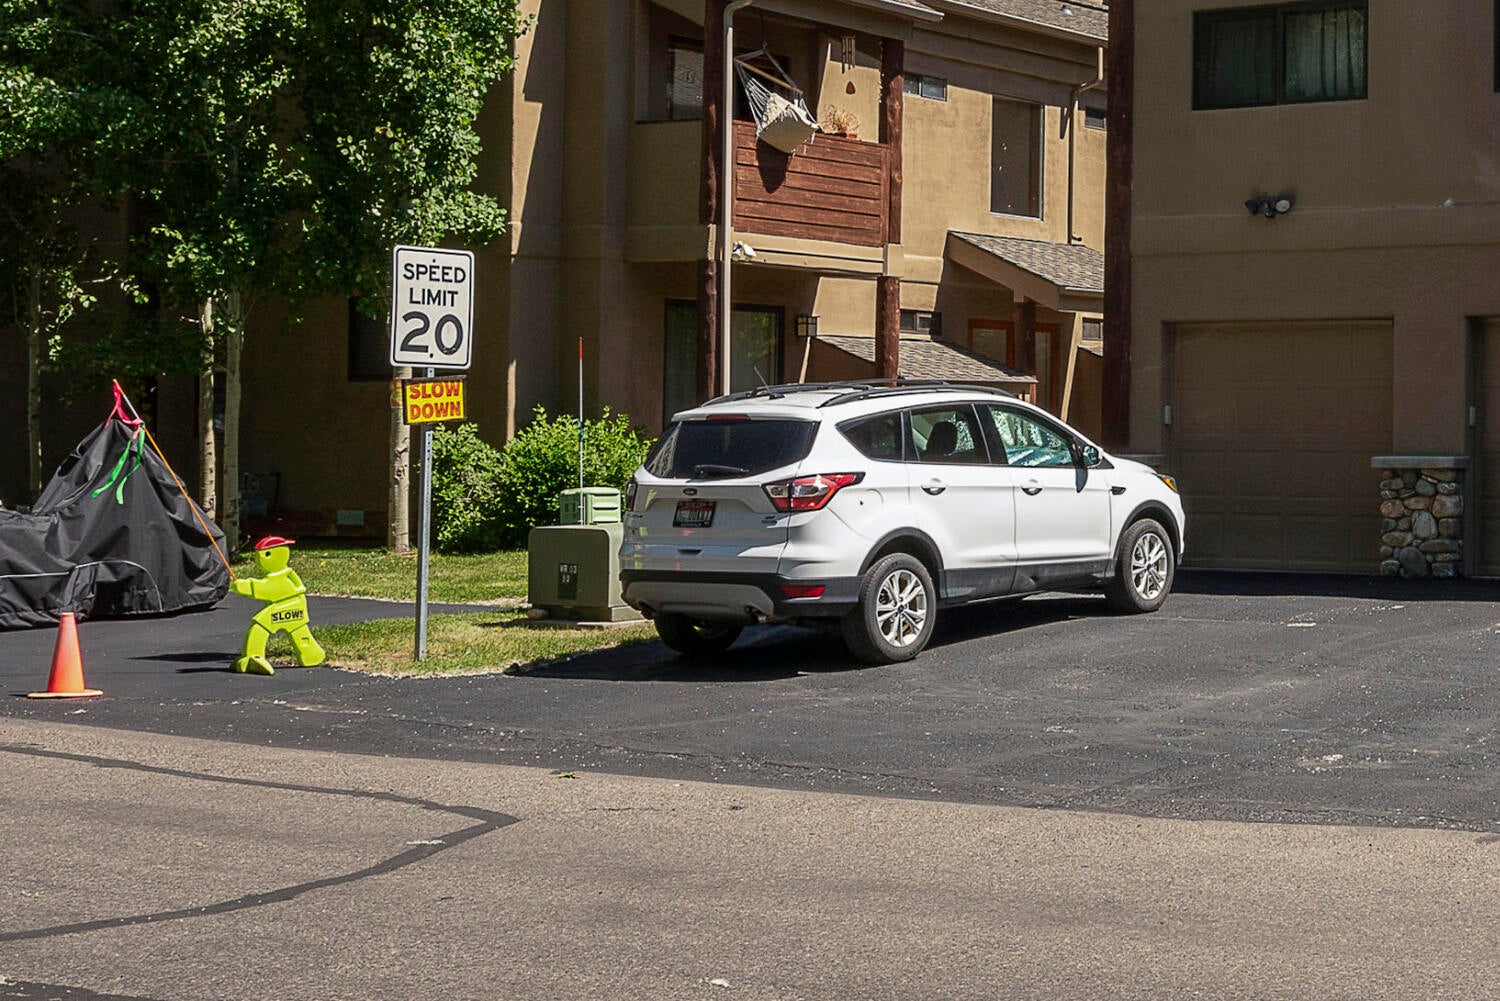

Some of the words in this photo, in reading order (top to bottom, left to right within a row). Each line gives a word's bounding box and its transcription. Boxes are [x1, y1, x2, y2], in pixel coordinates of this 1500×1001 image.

[403, 263, 466, 283] SPEED
[409, 287, 459, 307] LIMIT
[400, 311, 463, 355] 20
[409, 381, 461, 399] SLOW
[409, 401, 461, 420] DOWN
